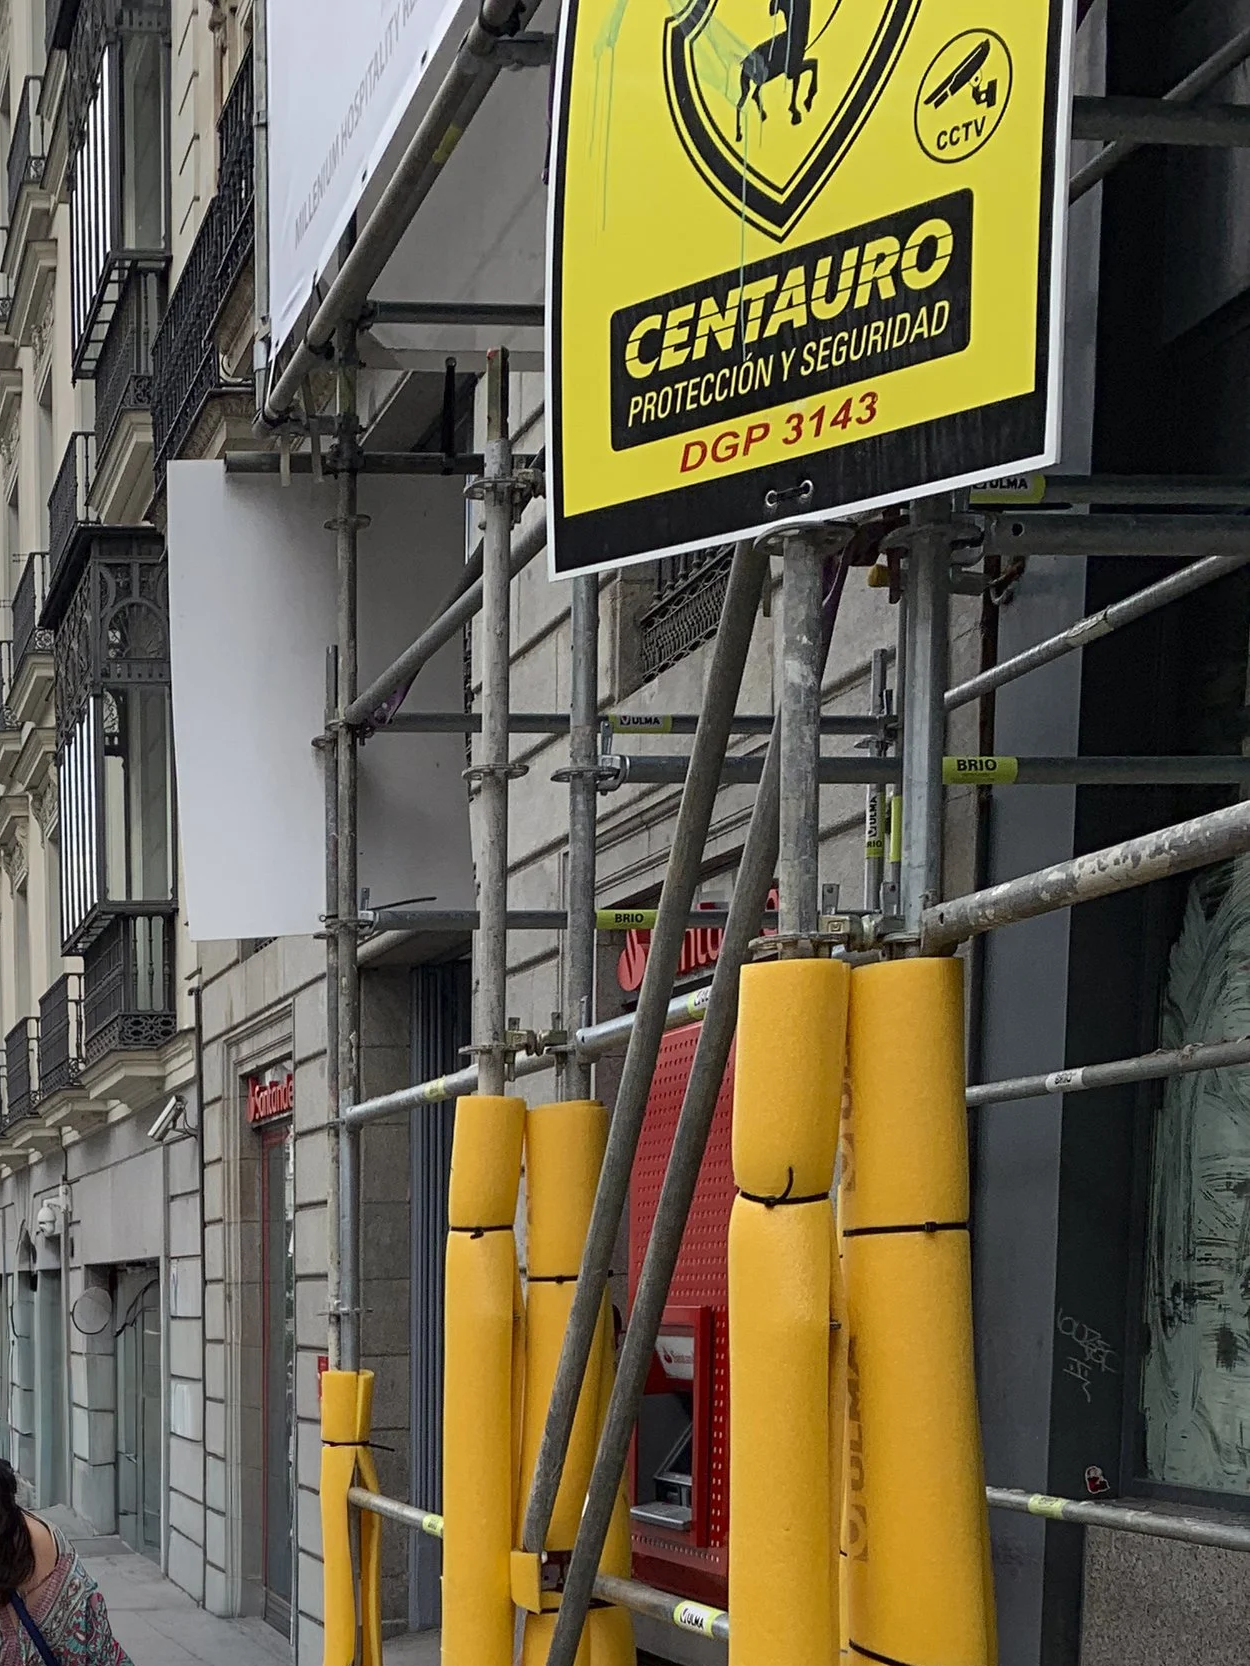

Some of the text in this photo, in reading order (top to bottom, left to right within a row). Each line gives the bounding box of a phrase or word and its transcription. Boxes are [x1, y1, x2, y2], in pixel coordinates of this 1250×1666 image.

[295, 134, 340, 250] MILLENIUM
[341, 4, 401, 156] HOSPITALITY
[935, 118, 988, 151] CCTV
[623, 217, 954, 381] CENTAURO
[627, 299, 950, 428] PROTECCIÓN Y SEGURIDAD
[679, 391, 879, 474] DGP 3143
[632, 716, 660, 725] ULMA
[956, 758, 997, 772] BRIO
[868, 795, 877, 825] ULMA
[615, 913, 644, 923] BRIO
